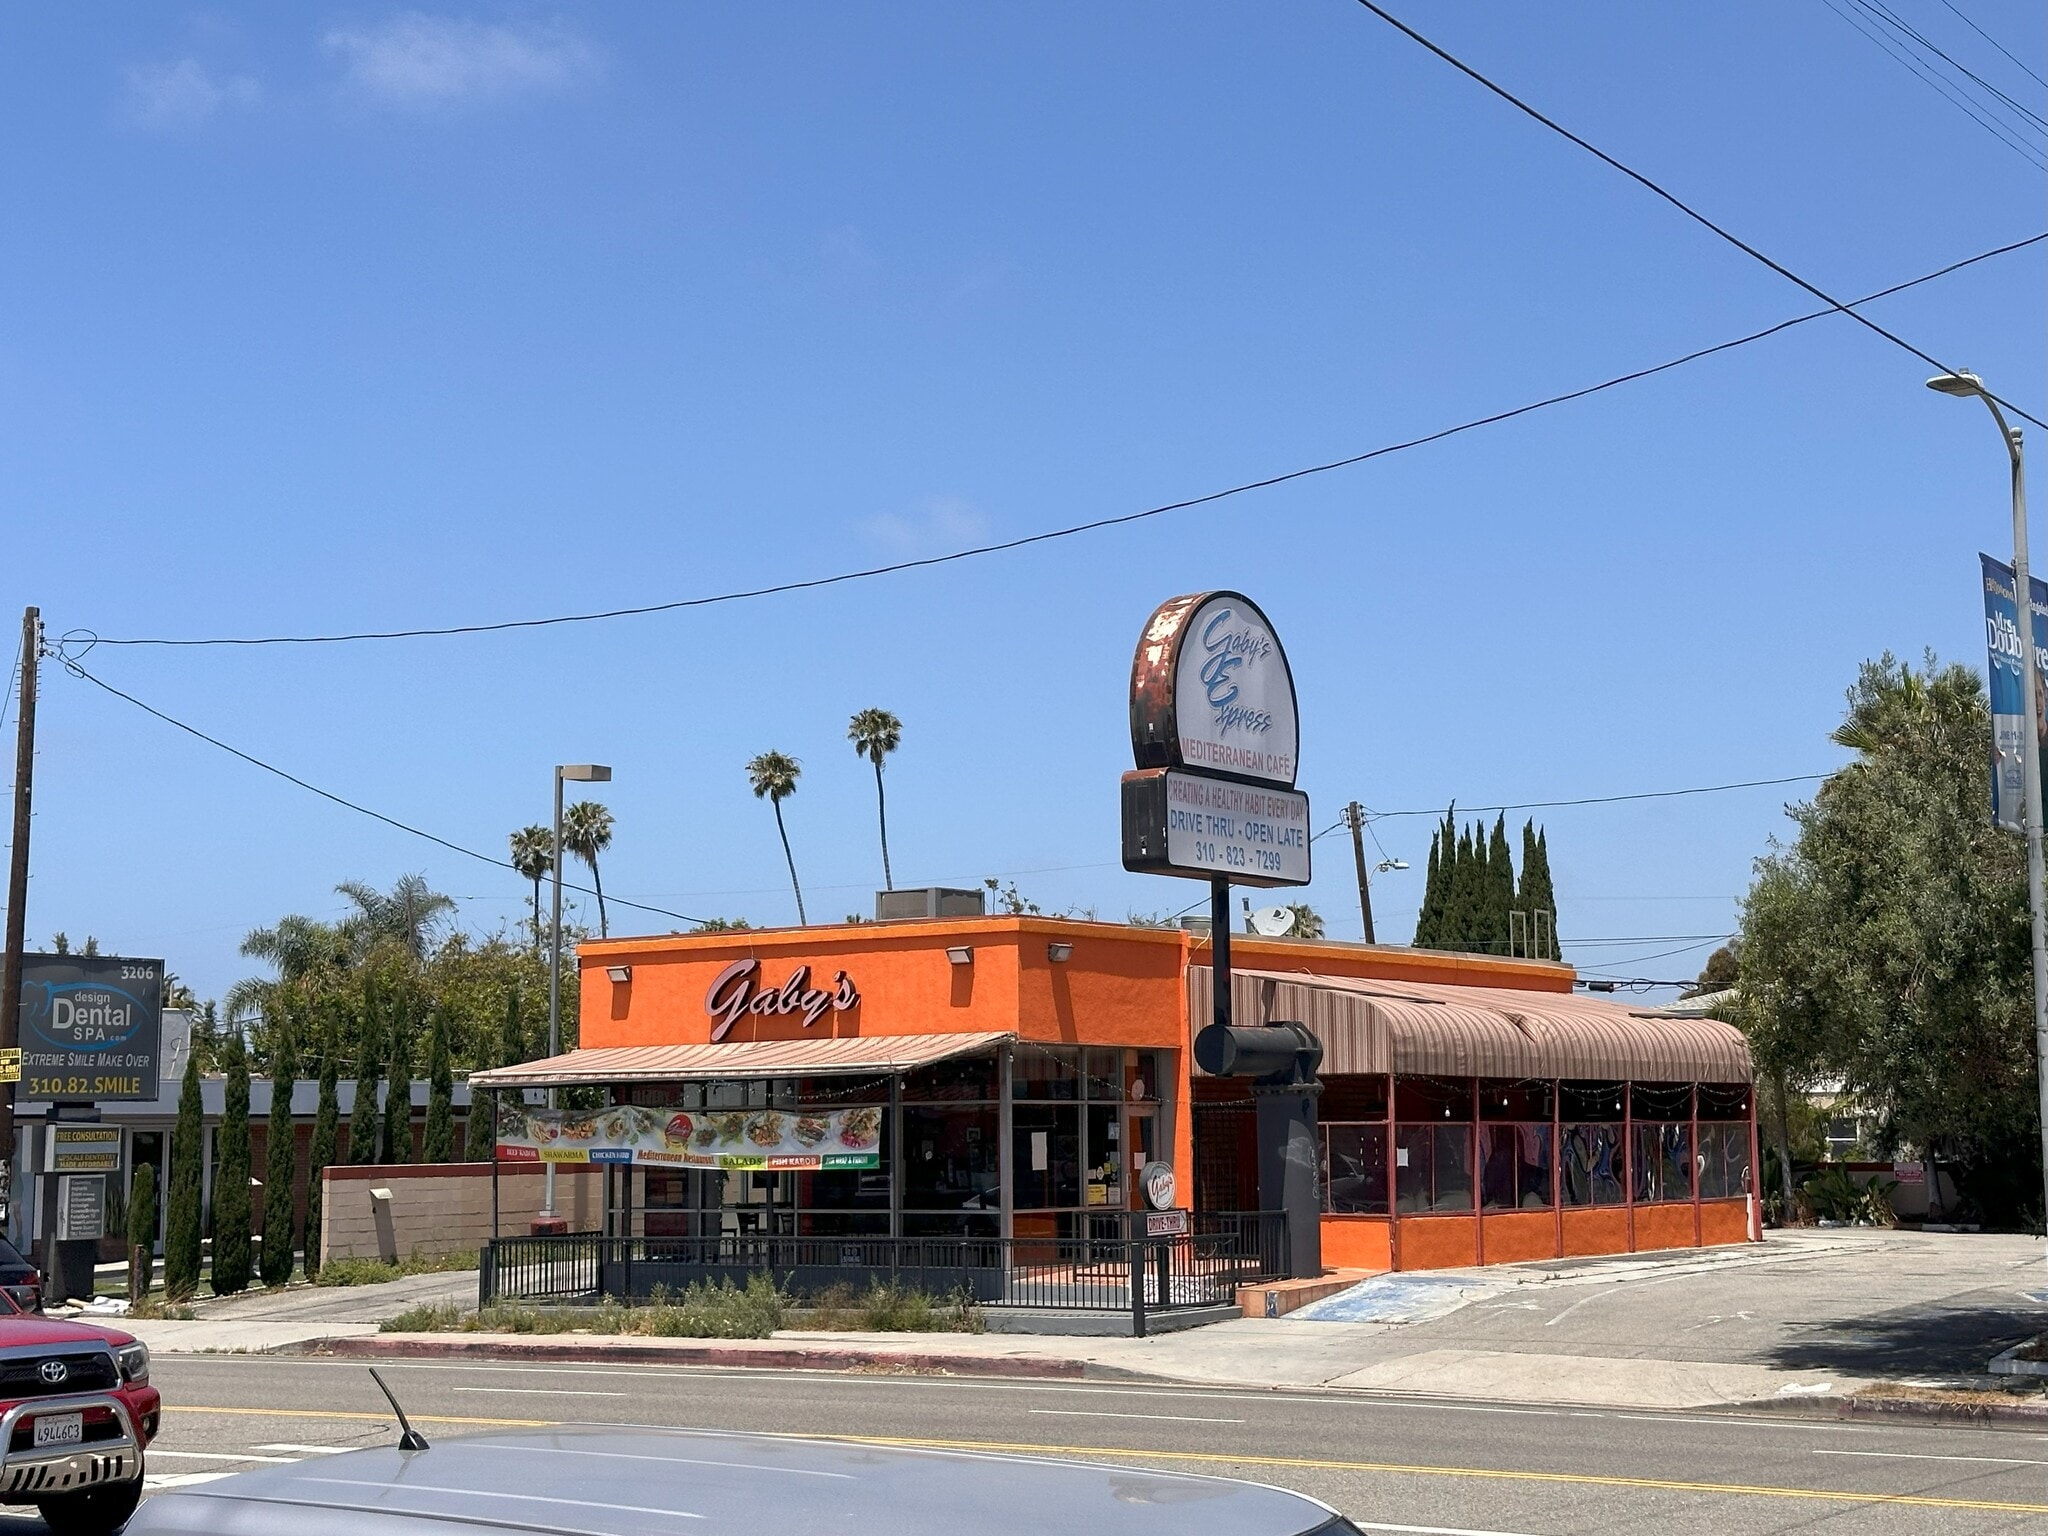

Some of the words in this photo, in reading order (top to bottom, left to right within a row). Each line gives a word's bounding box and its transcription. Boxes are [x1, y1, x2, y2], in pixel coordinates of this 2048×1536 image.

[1202, 607, 1272, 682] Gaby's
[1206, 656, 1272, 738] Express
[1182, 737, 1264, 771] MEDITERRANEAN
[1267, 753, 1291, 777] CAFÉ
[1168, 780, 1204, 806] CREATING
[1206, 788, 1210, 807] A
[1212, 787, 1244, 811] HEALTHY
[1245, 792, 1266, 815] HABIT
[1268, 796, 1289, 819] EVERY
[1291, 799, 1305, 821] DAY
[1170, 809, 1202, 833] DRIVE
[1206, 814, 1235, 839] THRU
[1245, 822, 1274, 845] OPEN
[1277, 827, 1303, 848] LATE
[1196, 841, 1215, 863] 310
[1226, 845, 1246, 867] 823
[1256, 849, 1281, 871] 7299
[121, 965, 154, 980] 3206
[74, 991, 111, 1005] design
[705, 958, 862, 1043] Gaby's
[52, 997, 131, 1030] Dental
[29, 1076, 141, 1095] 310.82.SMILE
[57, 1131, 72, 1141] FREE
[72, 1130, 118, 1141] CONSULTATION
[78, 1160, 114, 1168] AFFORDABLE
[637, 1149, 682, 1162] Mediterranean
[722, 1157, 762, 1166] SALADS
